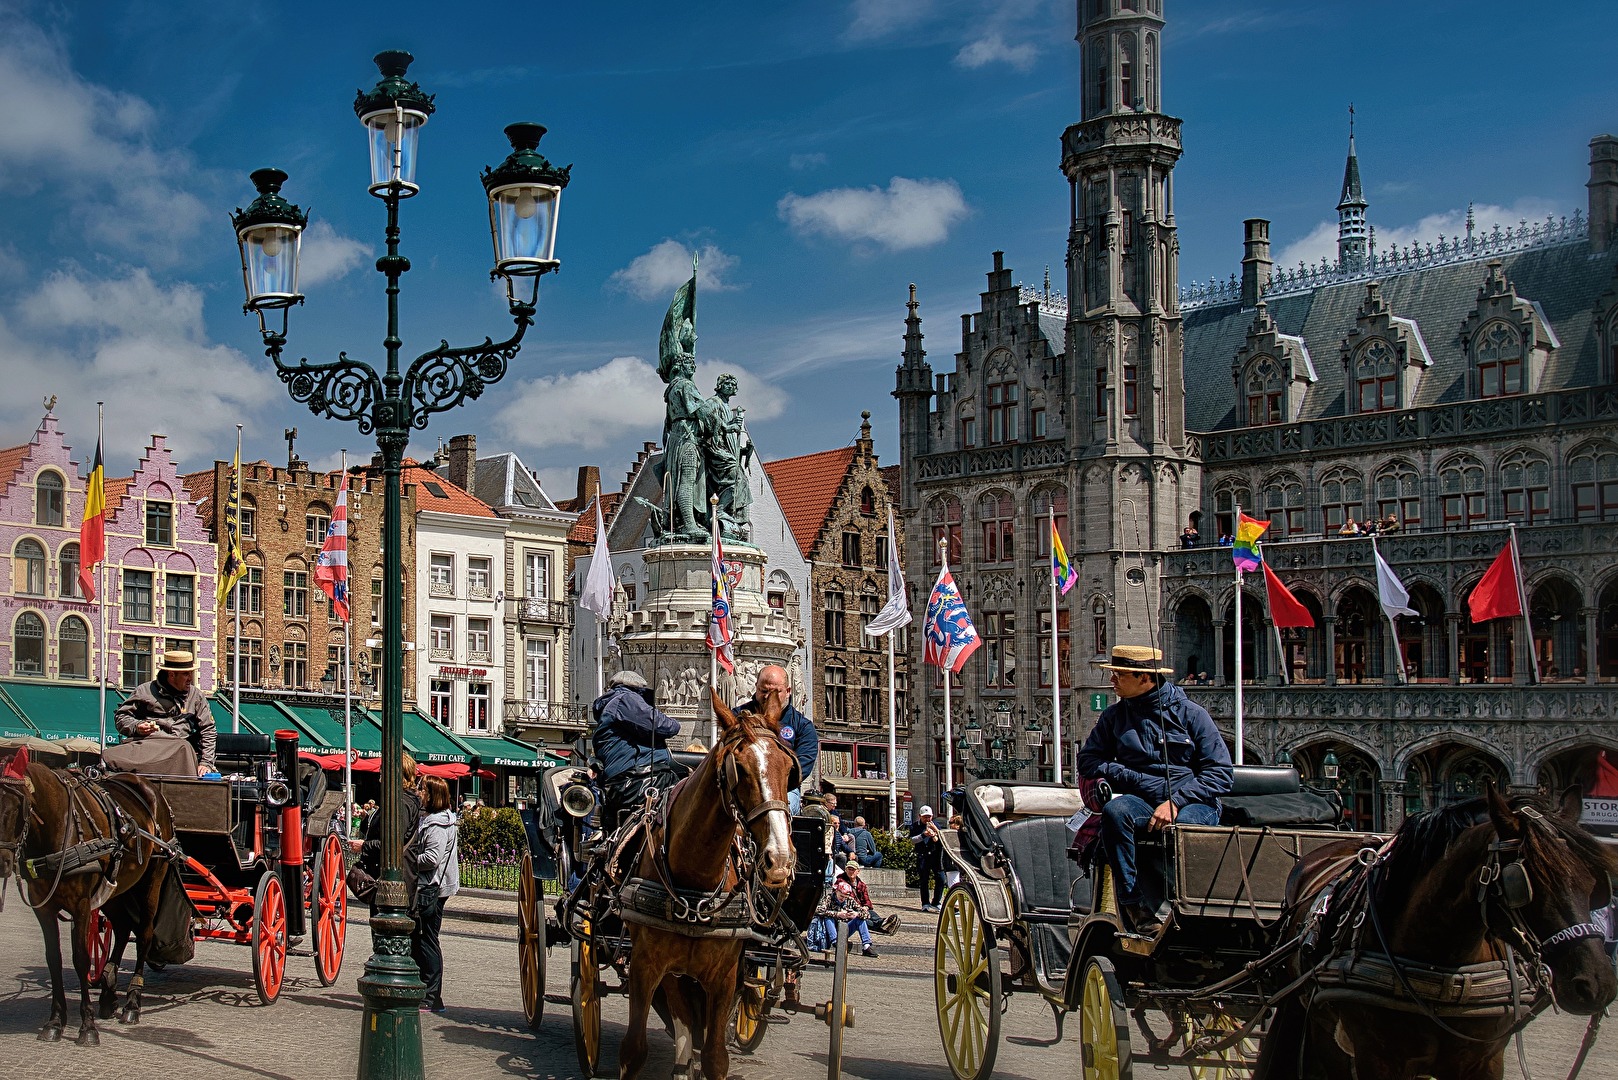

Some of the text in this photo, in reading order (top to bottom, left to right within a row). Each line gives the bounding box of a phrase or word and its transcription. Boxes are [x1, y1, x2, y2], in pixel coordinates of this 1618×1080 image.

[428, 753, 448, 761] PETIT
[494, 757, 529, 767] Friterie
[1551, 932, 1566, 945] DO
[1563, 923, 1590, 940] NOT
